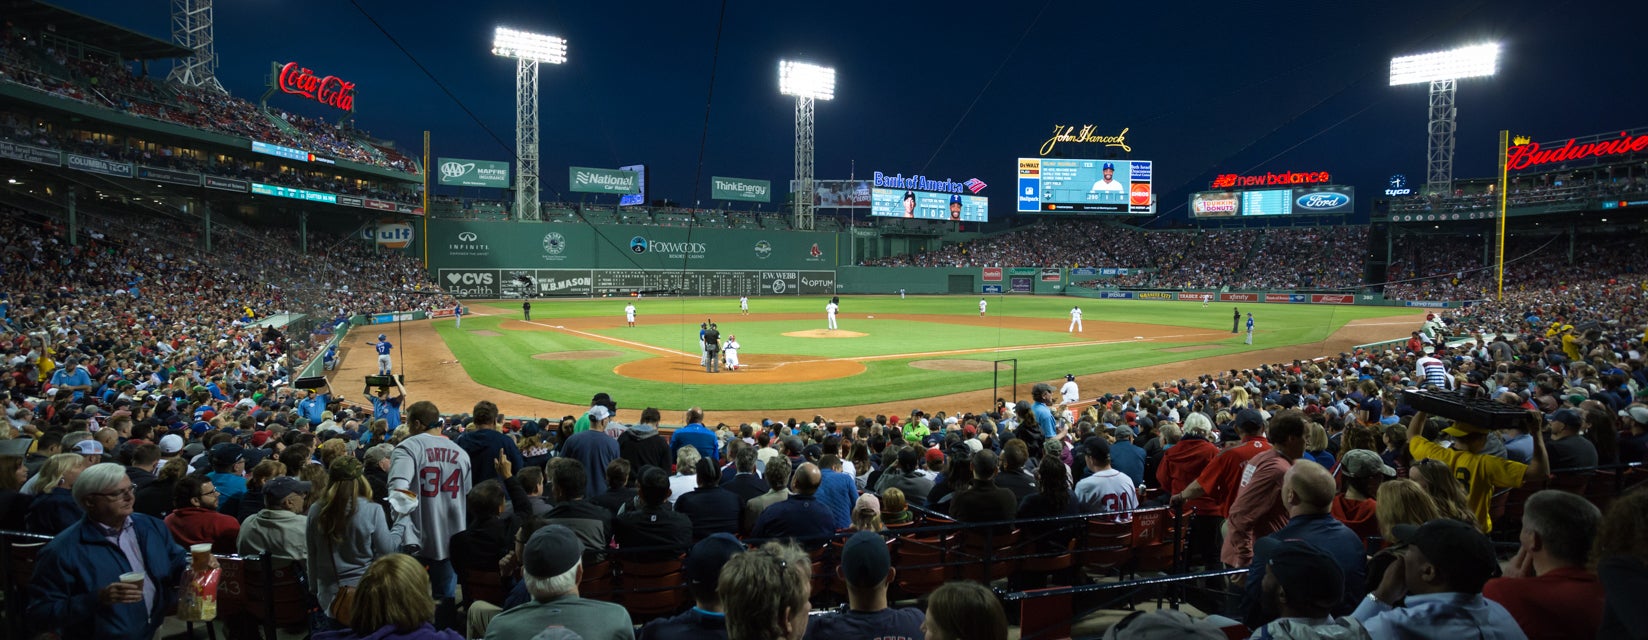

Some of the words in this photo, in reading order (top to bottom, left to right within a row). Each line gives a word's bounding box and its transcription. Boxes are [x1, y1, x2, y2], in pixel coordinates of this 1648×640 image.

[279, 61, 355, 111] Coca-Cola
[1040, 124, 1076, 156] John
[1077, 124, 1132, 152] Hancock
[70, 156, 108, 169] COLUMBIA
[109, 163, 129, 174] TECH
[588, 173, 633, 186] National
[874, 171, 905, 188] Bank
[905, 175, 918, 190] of
[919, 175, 963, 193] America
[1237, 175, 1267, 187] new
[1267, 170, 1329, 185] balance
[1306, 193, 1339, 208] Ford
[649, 240, 706, 253] FOXWOODS
[462, 273, 494, 285] CVS
[776, 272, 797, 280] WEBB
[425, 447, 459, 464] ORTIZ
[419, 466, 461, 499] 34
[1139, 528, 1155, 538] 41
